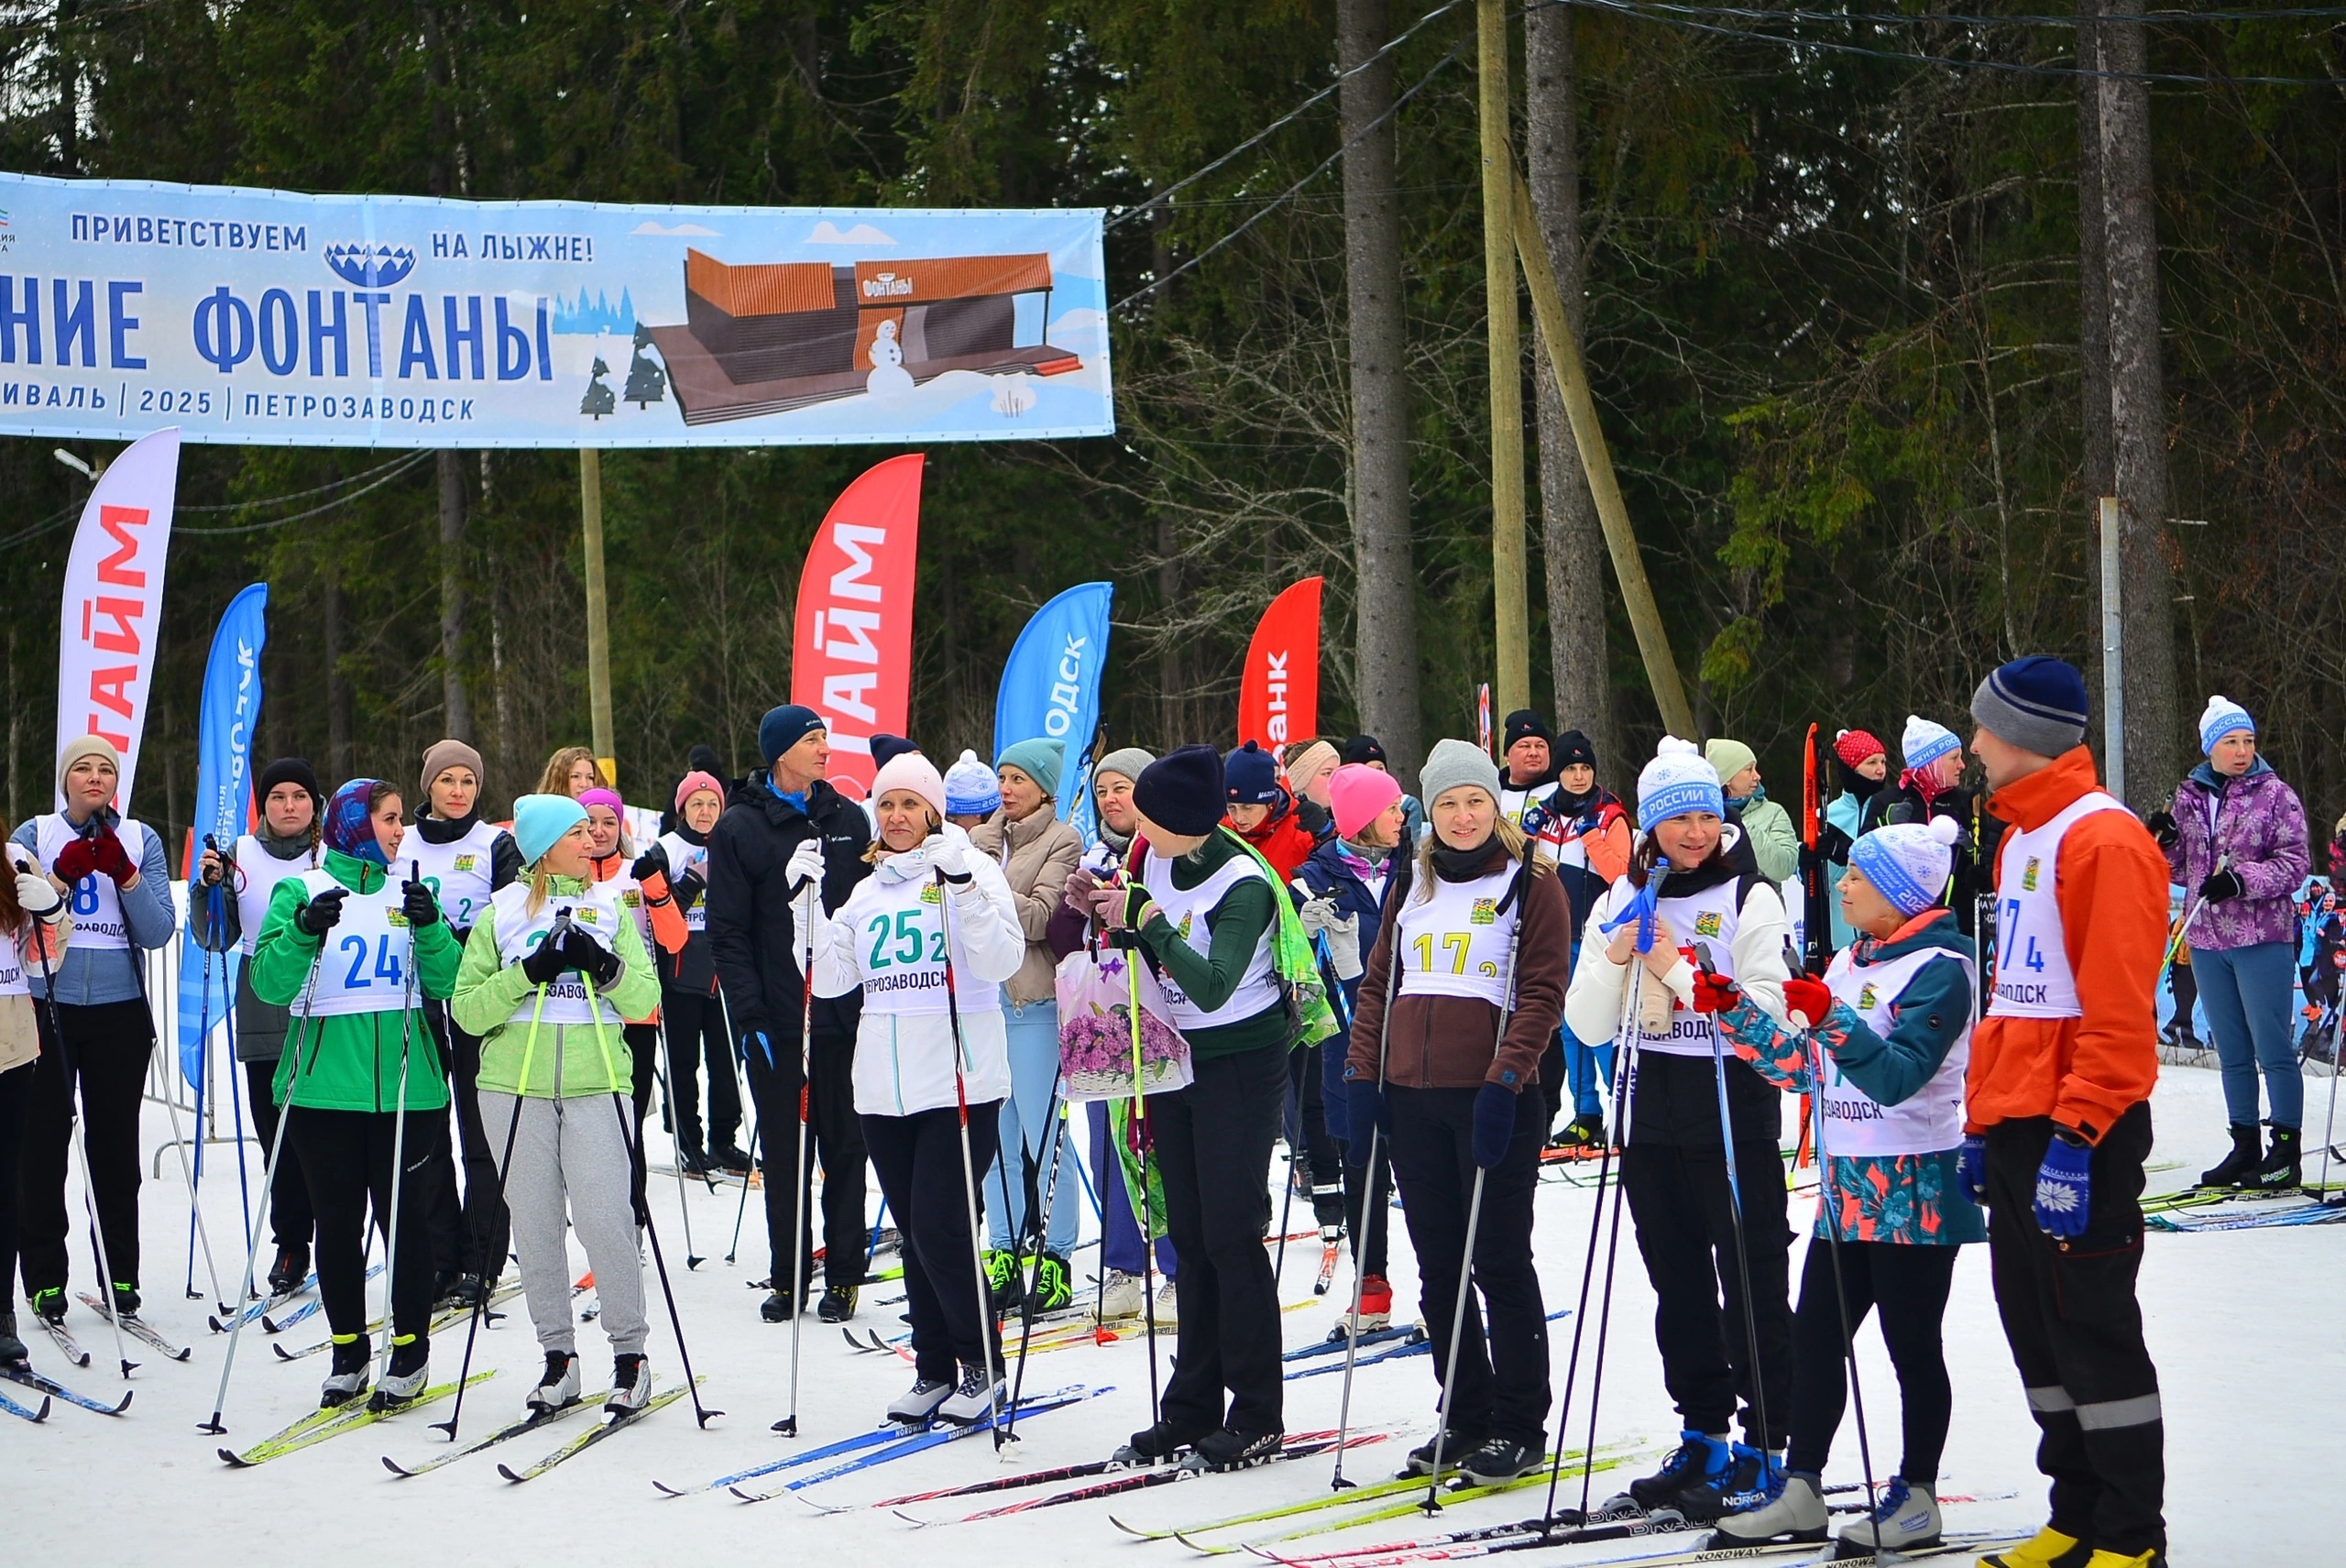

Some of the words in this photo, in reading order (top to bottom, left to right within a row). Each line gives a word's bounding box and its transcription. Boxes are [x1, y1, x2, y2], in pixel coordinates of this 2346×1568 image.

[71, 214, 306, 251] ПРИВЕТСТВУЕМ
[433, 233, 468, 259] НА
[481, 234, 594, 262] ЛЫЖНЕ!
[0, 276, 148, 369] НИЕ
[193, 286, 554, 381] ФОНТАНЫ
[3, 381, 107, 410] ИВАЛЬ
[139, 389, 212, 415] 2025
[245, 394, 476, 424] ПЕТРОЗАВОДСК
[1650, 789, 1705, 816] РОССИИ
[458, 897, 472, 923] 2
[867, 909, 923, 970] 25
[929, 932, 948, 962] 2
[1413, 932, 1472, 975] 17
[2024, 936, 2045, 972] 4
[340, 935, 401, 990] 24
[2235, 1190, 2303, 1201] FISCHER
[895, 1422, 926, 1438] NORDWAY
[948, 1425, 975, 1440] NORDWAY
[1694, 1547, 1763, 1562] NORDWAY
